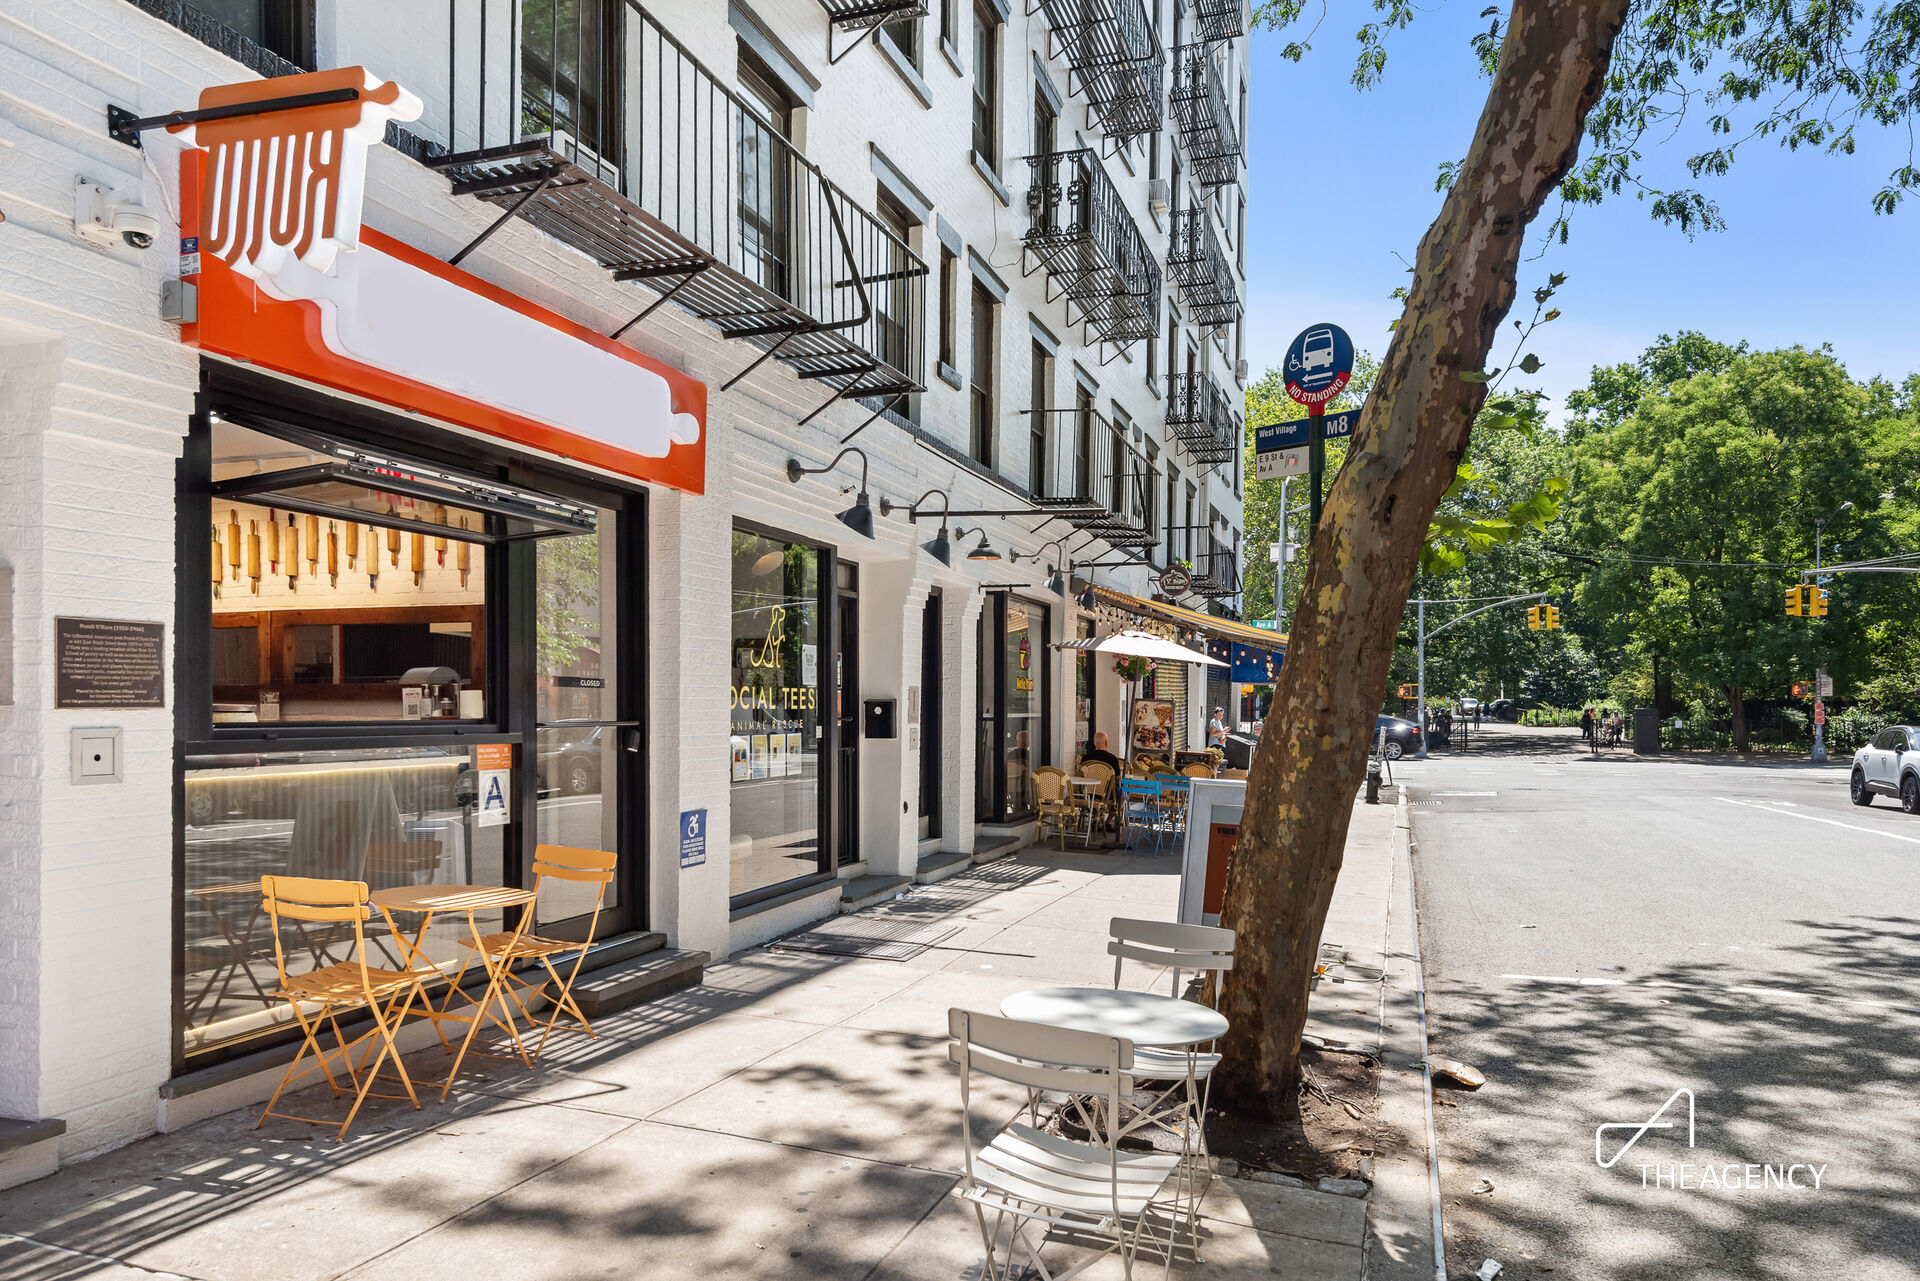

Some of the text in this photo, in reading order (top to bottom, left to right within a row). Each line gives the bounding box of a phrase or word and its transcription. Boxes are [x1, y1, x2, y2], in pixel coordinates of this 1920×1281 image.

[1289, 378, 1344, 403] NO STANDING
[1258, 424, 1297, 438] West Village
[1326, 415, 1349, 436] M8
[1259, 452, 1285, 463] E 9 St &
[1259, 464, 1273, 473] Av A
[1256, 621, 1266, 629] Ave
[782, 687, 816, 710] TEES
[731, 719, 804, 731] ANIMAL RESCUE
[484, 776, 505, 810] A
